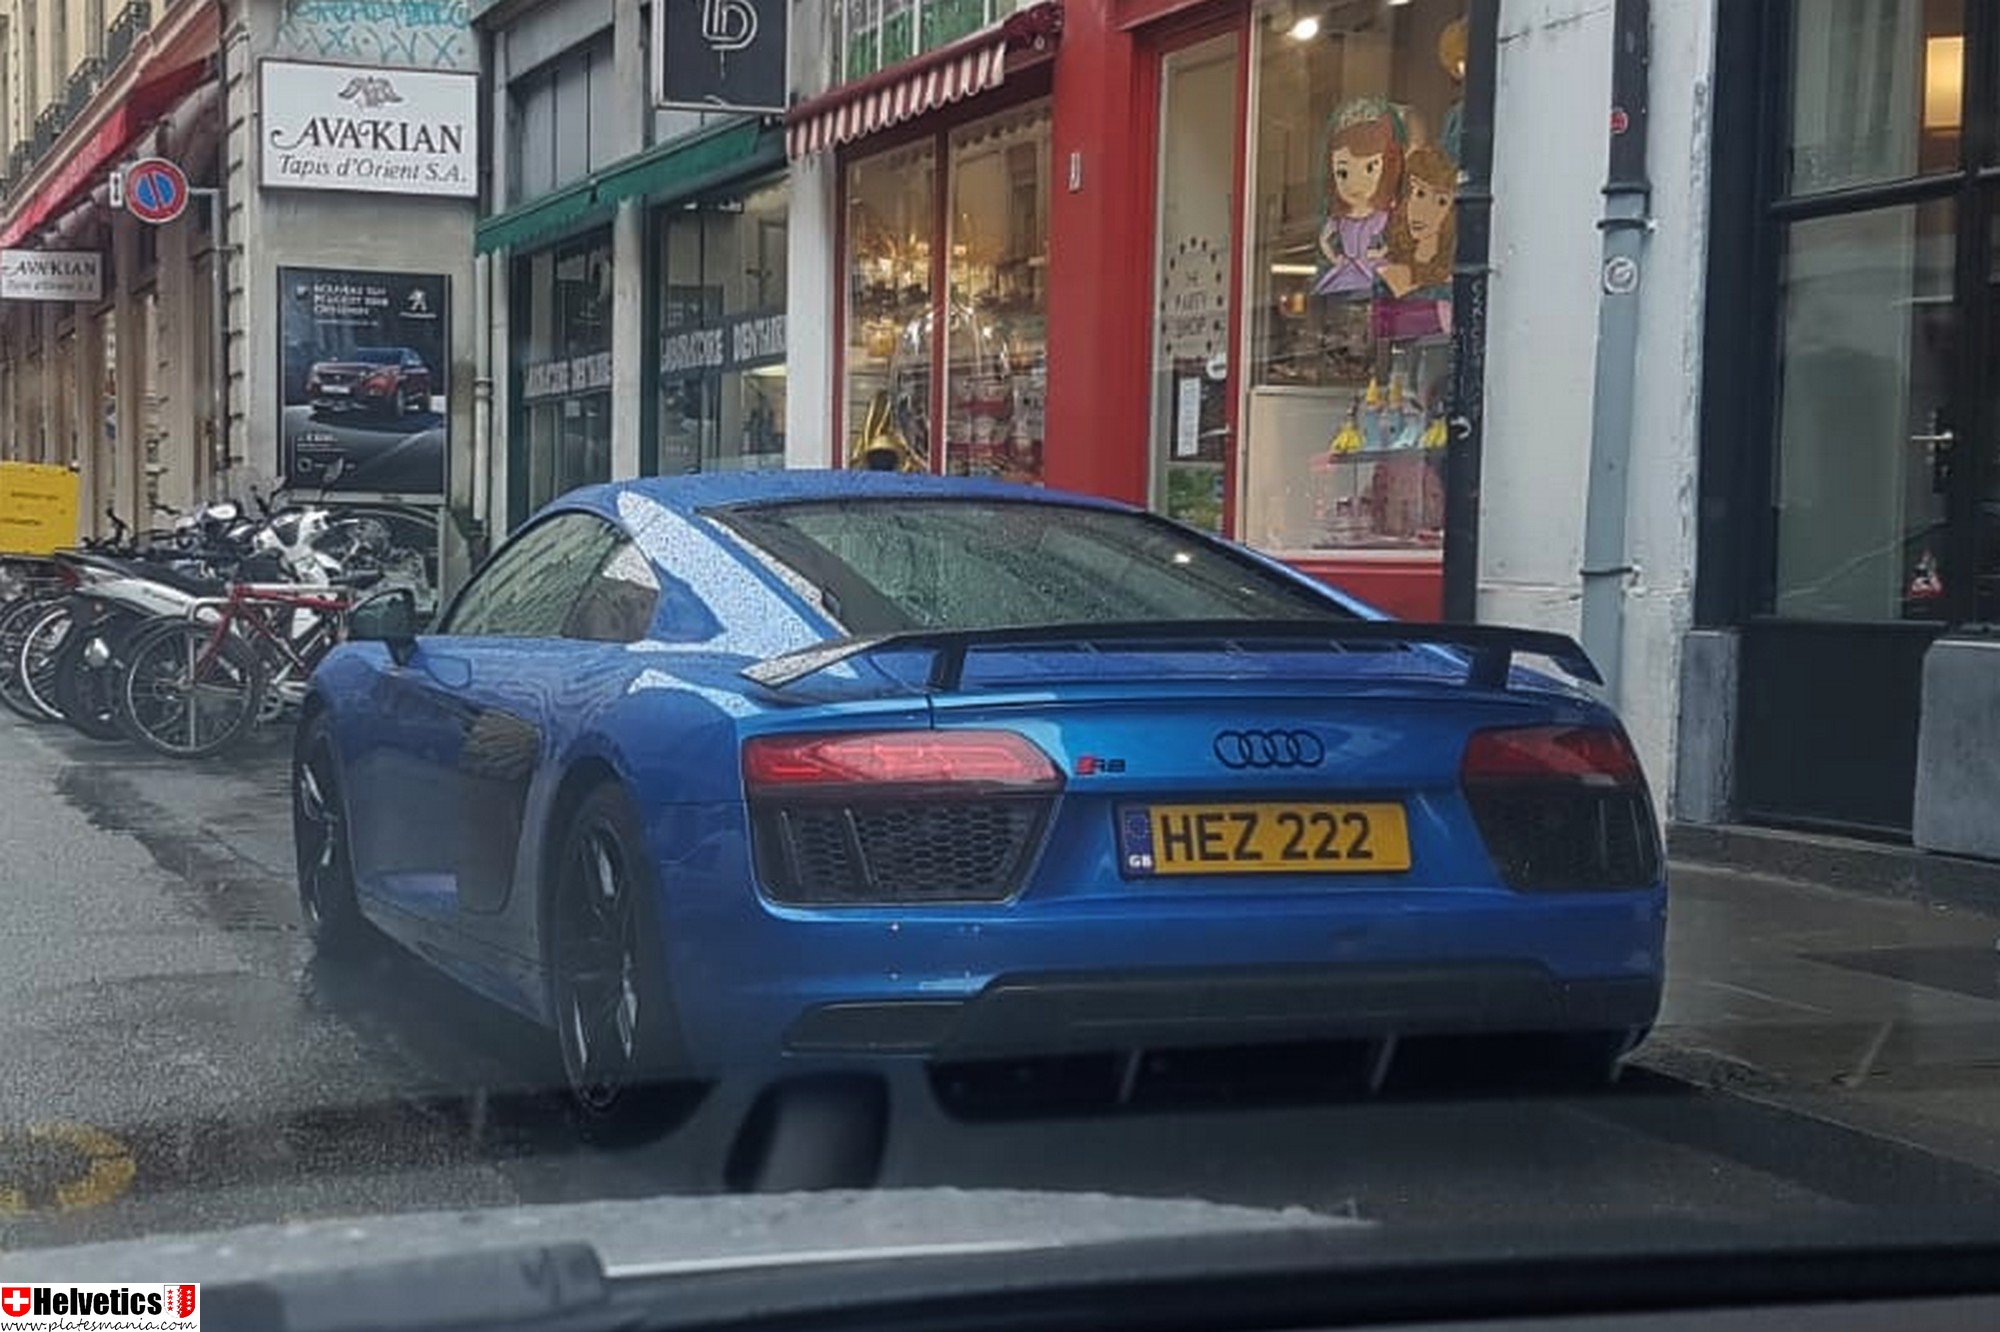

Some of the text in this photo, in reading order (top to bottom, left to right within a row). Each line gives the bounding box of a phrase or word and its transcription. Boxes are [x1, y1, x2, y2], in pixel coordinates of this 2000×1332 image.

[271, 117, 463, 154] AVAKIAN
[280, 153, 330, 179] Tapis
[425, 163, 467, 183] S.A.
[2, 260, 96, 277] AVAKIAN
[1160, 811, 1374, 861] HEZ 222
[1128, 854, 1152, 868] GB
